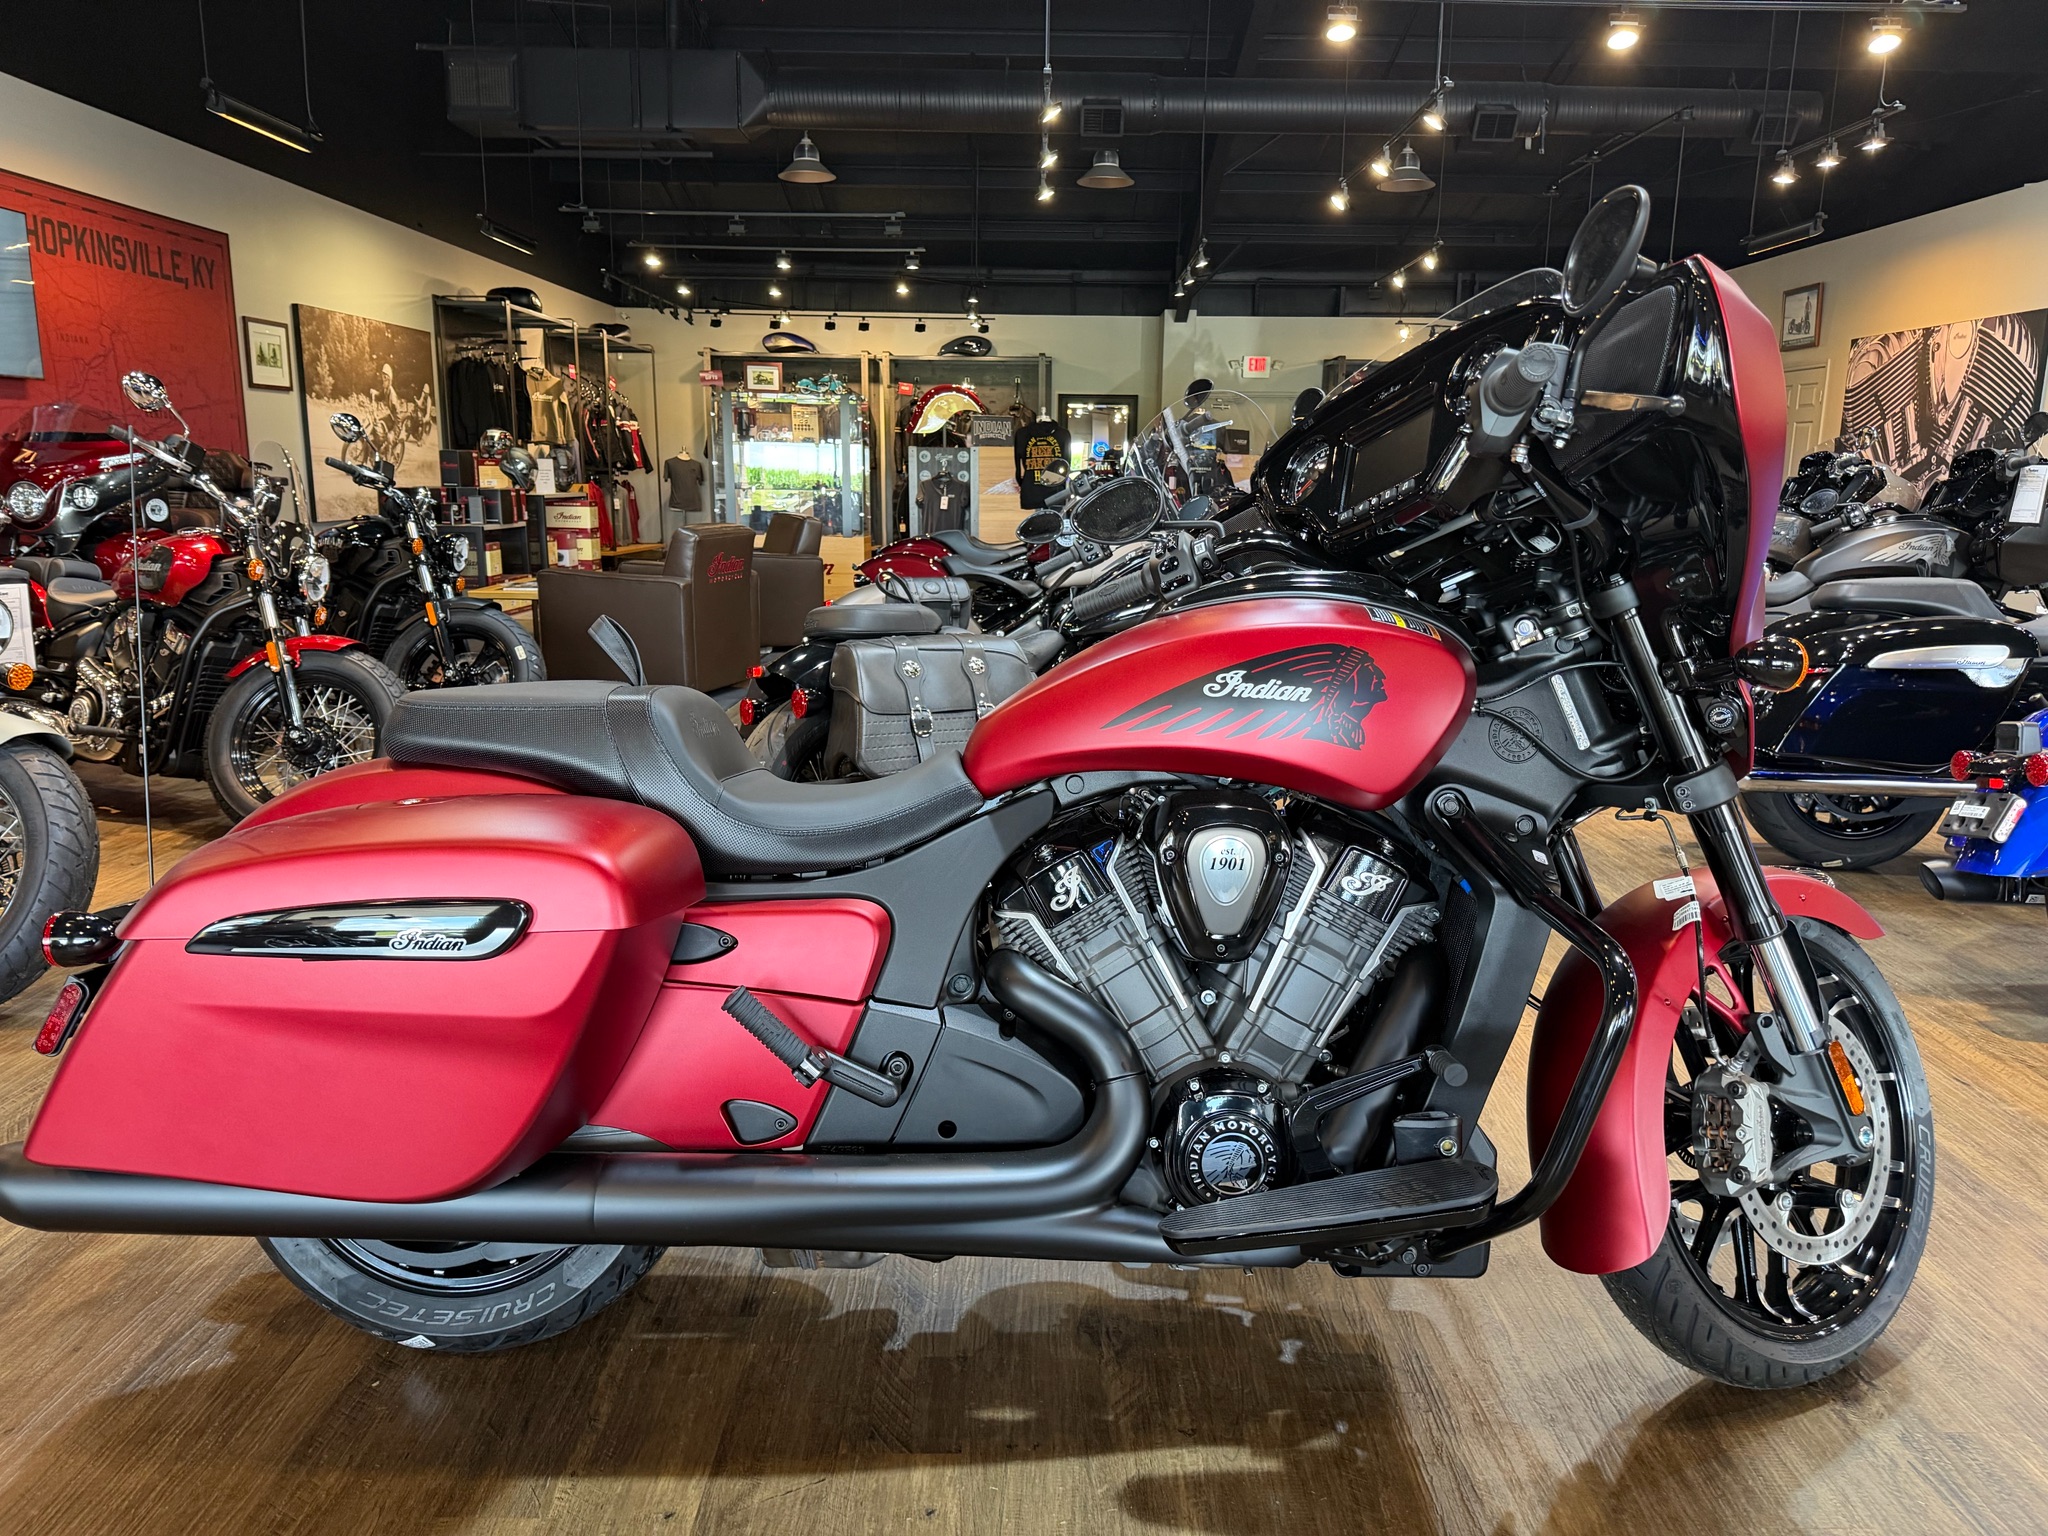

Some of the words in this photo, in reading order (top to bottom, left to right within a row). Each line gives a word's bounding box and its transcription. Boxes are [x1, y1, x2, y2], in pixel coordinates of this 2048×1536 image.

[27, 214, 190, 290] HOPKINSVILLE,
[191, 253, 216, 290] KY
[55, 332, 90, 345] INDIANA
[1248, 357, 1267, 372] EXIT
[973, 420, 1012, 437] INDIAN
[979, 433, 1007, 441] MOTORCYCLE
[553, 511, 582, 520] Indian
[1899, 541, 1934, 552] Indian
[707, 551, 745, 577] Indian
[1203, 670, 1312, 702] Indian
[1220, 847, 1236, 856] est.
[1209, 856, 1246, 871] 1901
[390, 928, 466, 952] Indian
[1189, 1131, 1211, 1190] INDIAN
[1211, 1120, 1277, 1192] MOTORCYCLE
[356, 1281, 556, 1326] CRUISETEC
